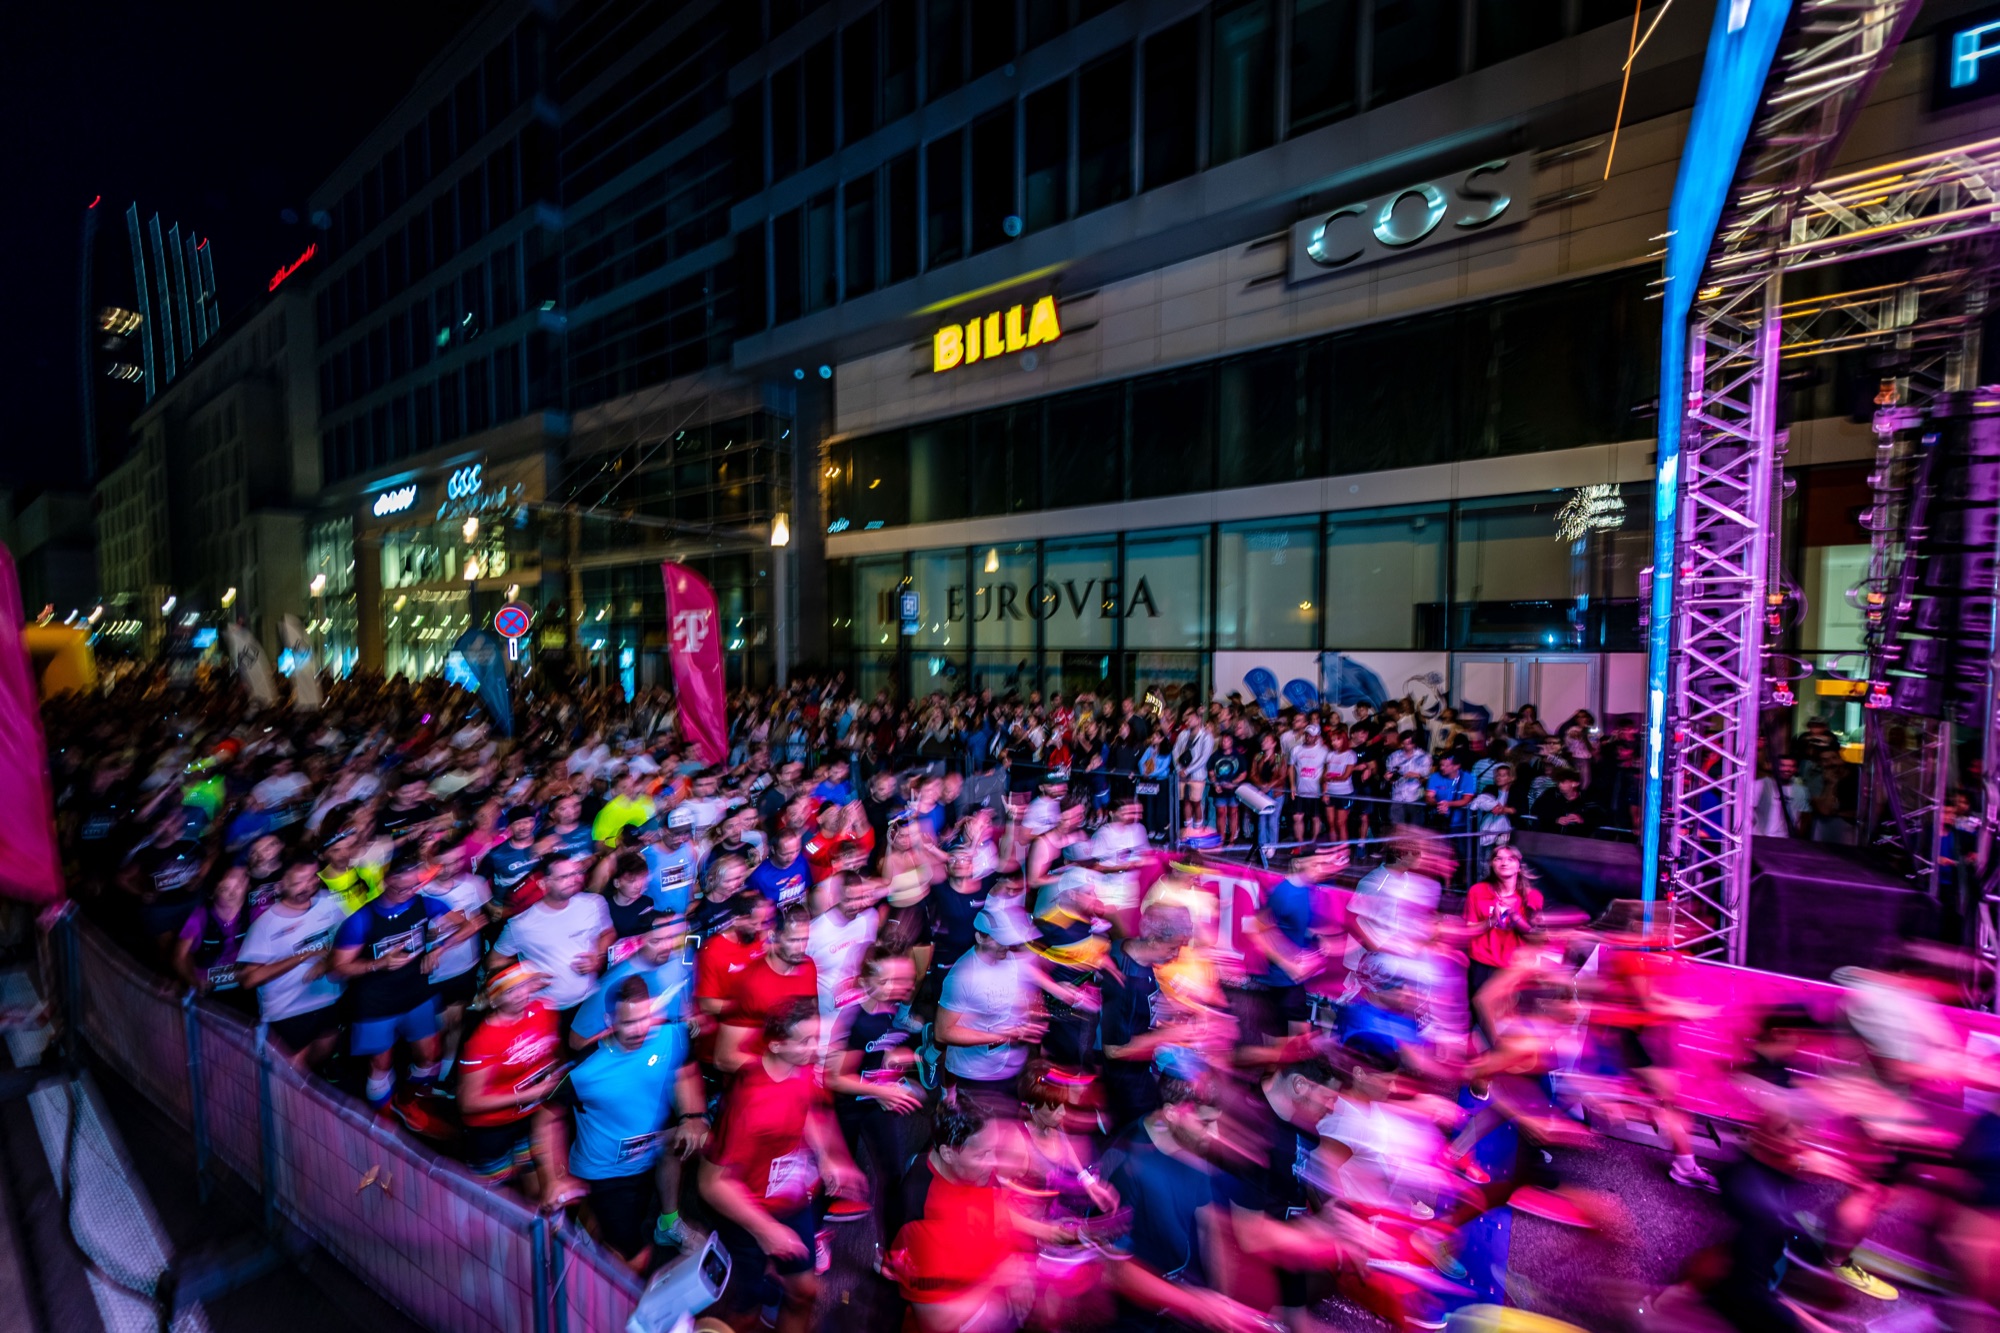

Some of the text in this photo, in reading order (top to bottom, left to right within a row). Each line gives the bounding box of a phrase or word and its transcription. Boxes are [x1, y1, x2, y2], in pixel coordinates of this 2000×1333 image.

[1306, 159, 1512, 268] COS
[933, 294, 1062, 373] BILLA
[945, 574, 1161, 622] EUROVEA
[673, 609, 710, 653] T
